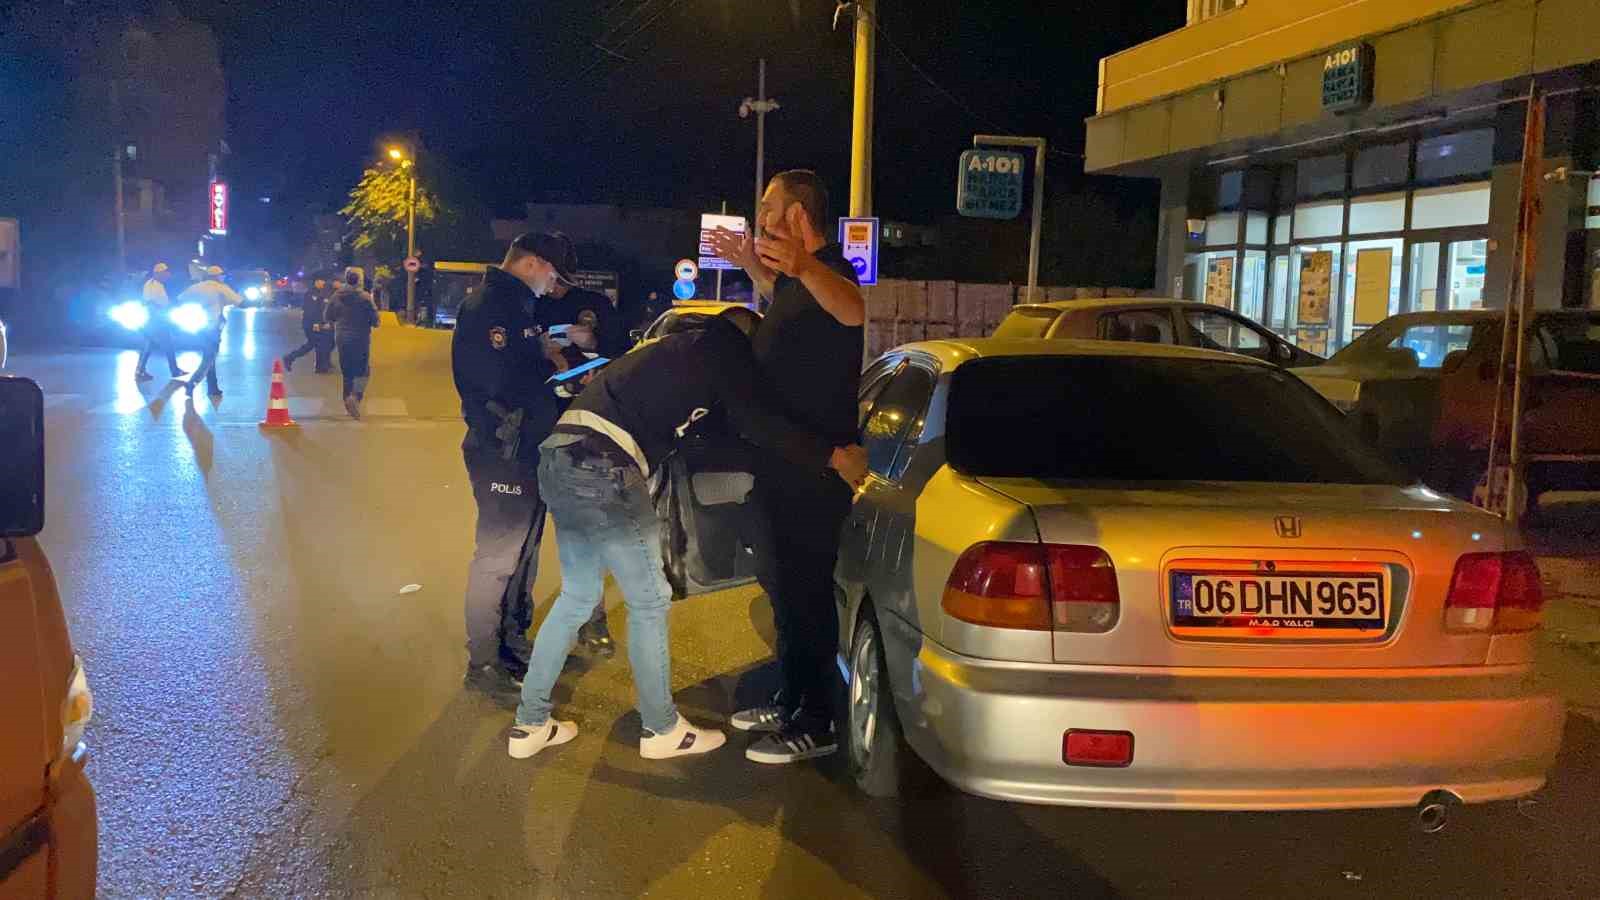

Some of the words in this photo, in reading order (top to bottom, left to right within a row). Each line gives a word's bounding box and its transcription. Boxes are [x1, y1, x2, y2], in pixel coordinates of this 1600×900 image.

[1177, 600, 1192, 609] TR
[1195, 580, 1235, 614] 06
[1240, 580, 1312, 615] DHN
[1316, 581, 1376, 616] 965
